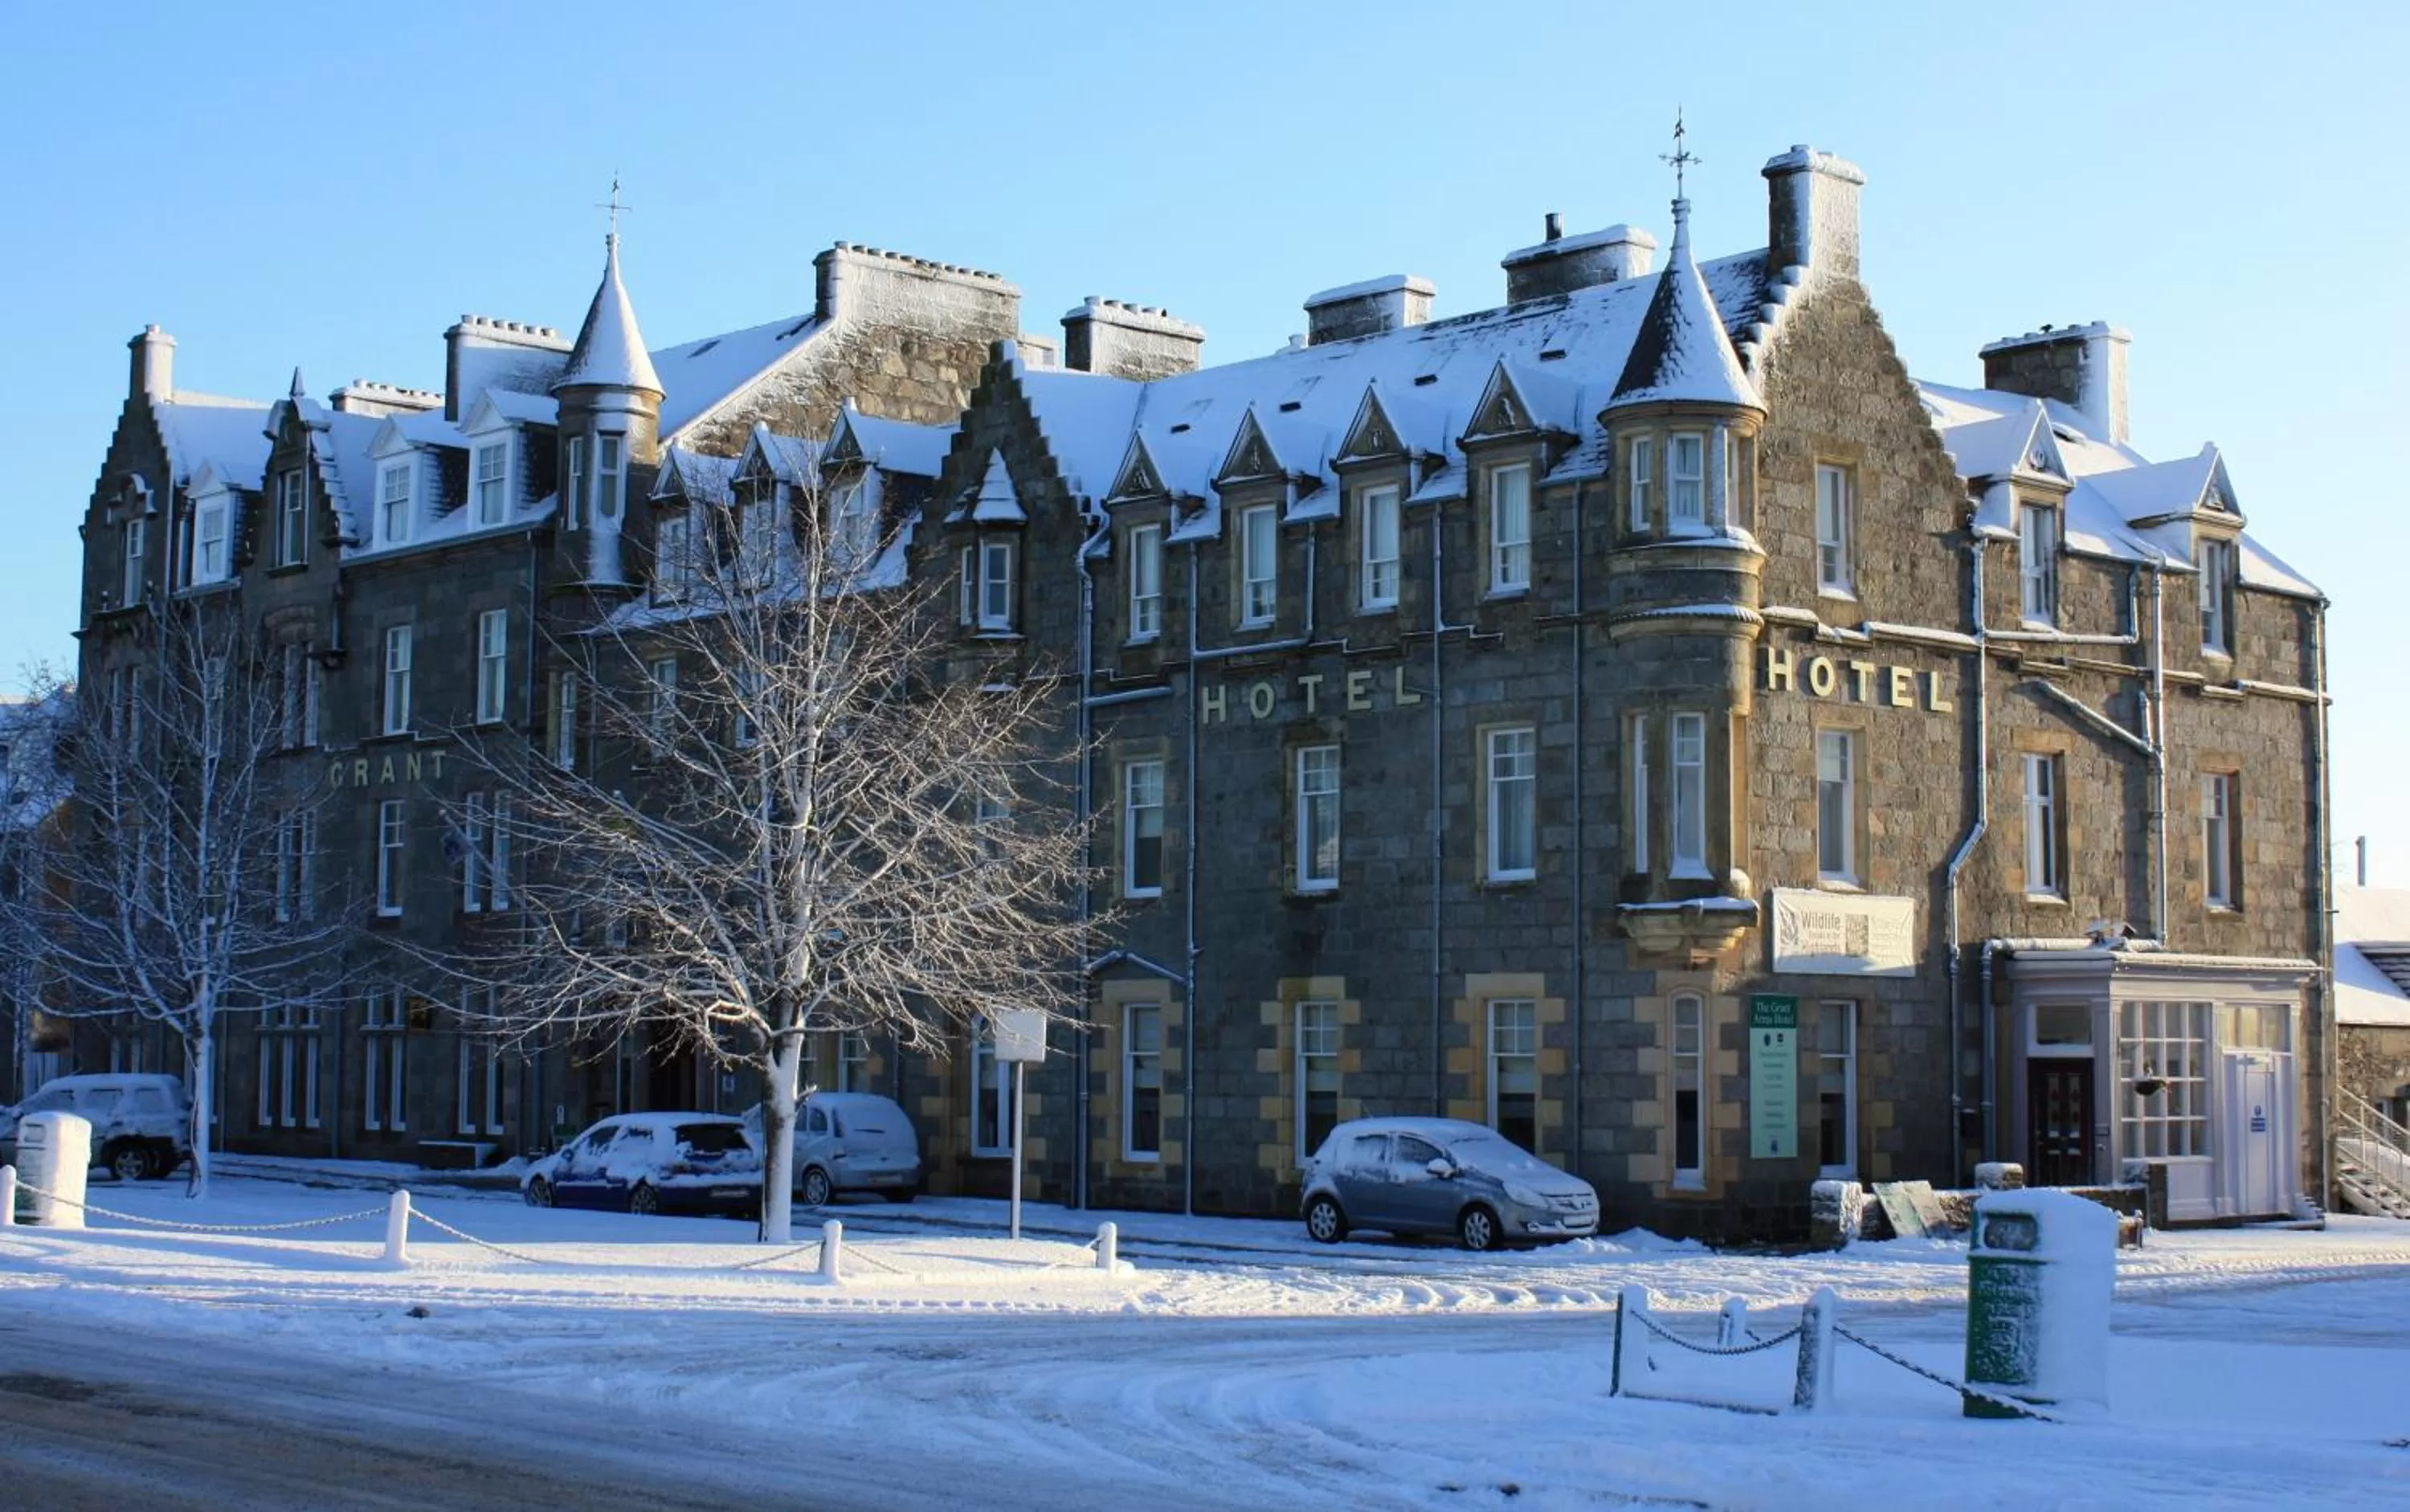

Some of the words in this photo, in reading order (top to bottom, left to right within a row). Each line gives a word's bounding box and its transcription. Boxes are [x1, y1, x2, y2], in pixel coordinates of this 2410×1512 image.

[1203, 666, 1421, 724] HOTEL
[1767, 646, 1953, 713] HOTEL
[330, 750, 446, 789] GRANT
[1801, 909, 1840, 930] Wildlife
